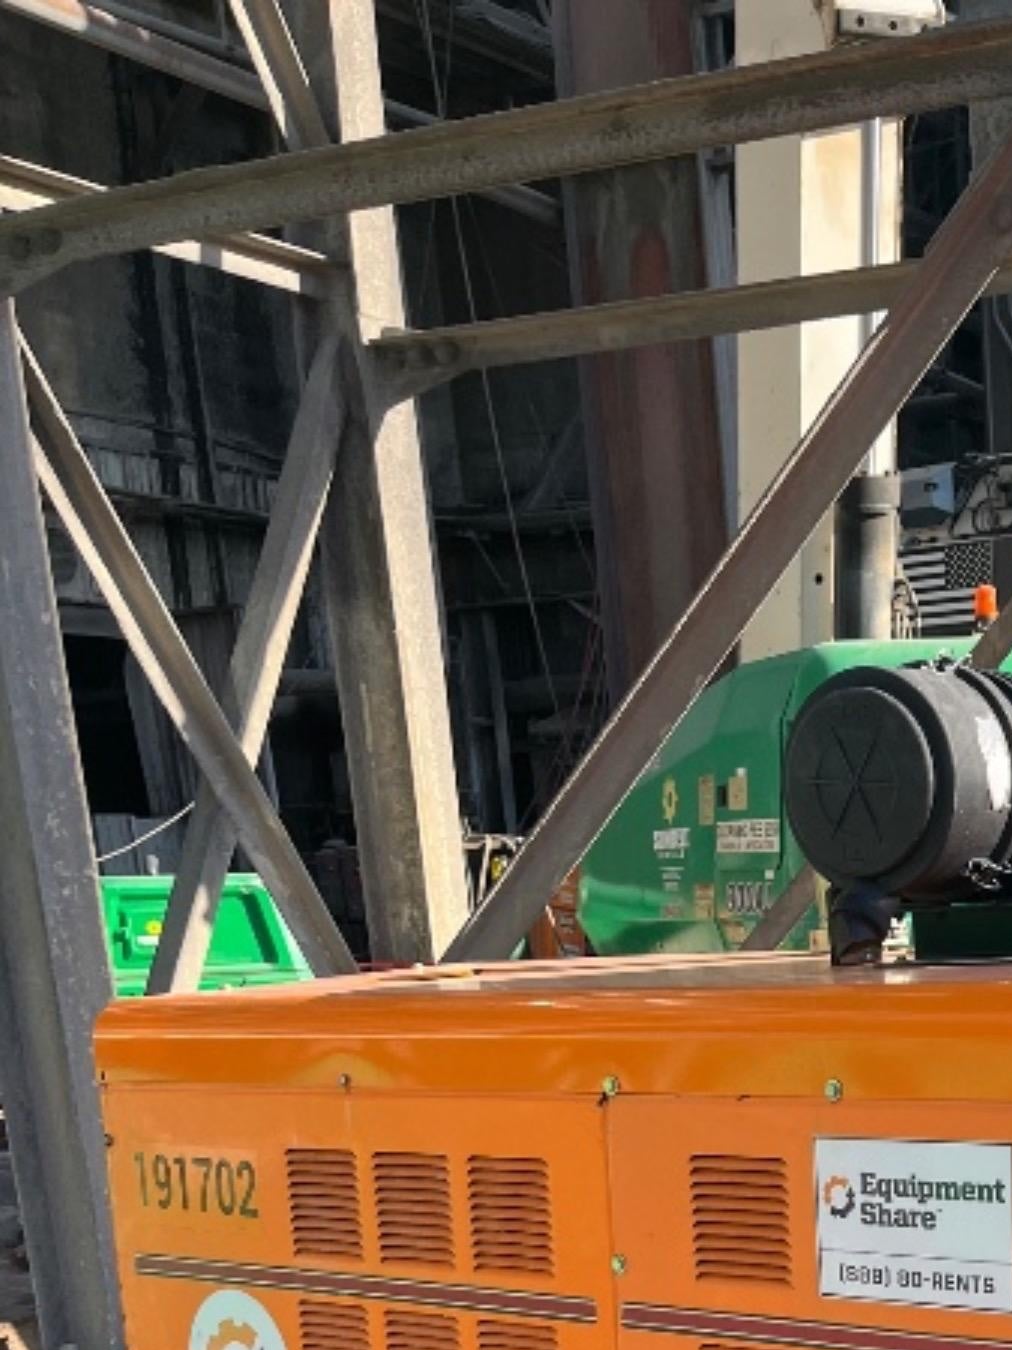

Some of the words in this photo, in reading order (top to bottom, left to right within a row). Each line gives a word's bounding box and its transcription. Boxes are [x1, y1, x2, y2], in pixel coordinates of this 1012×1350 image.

[132, 1151, 260, 1218] 191702
[859, 1171, 1006, 1204] Equipment
[859, 1203, 938, 1231] Share
